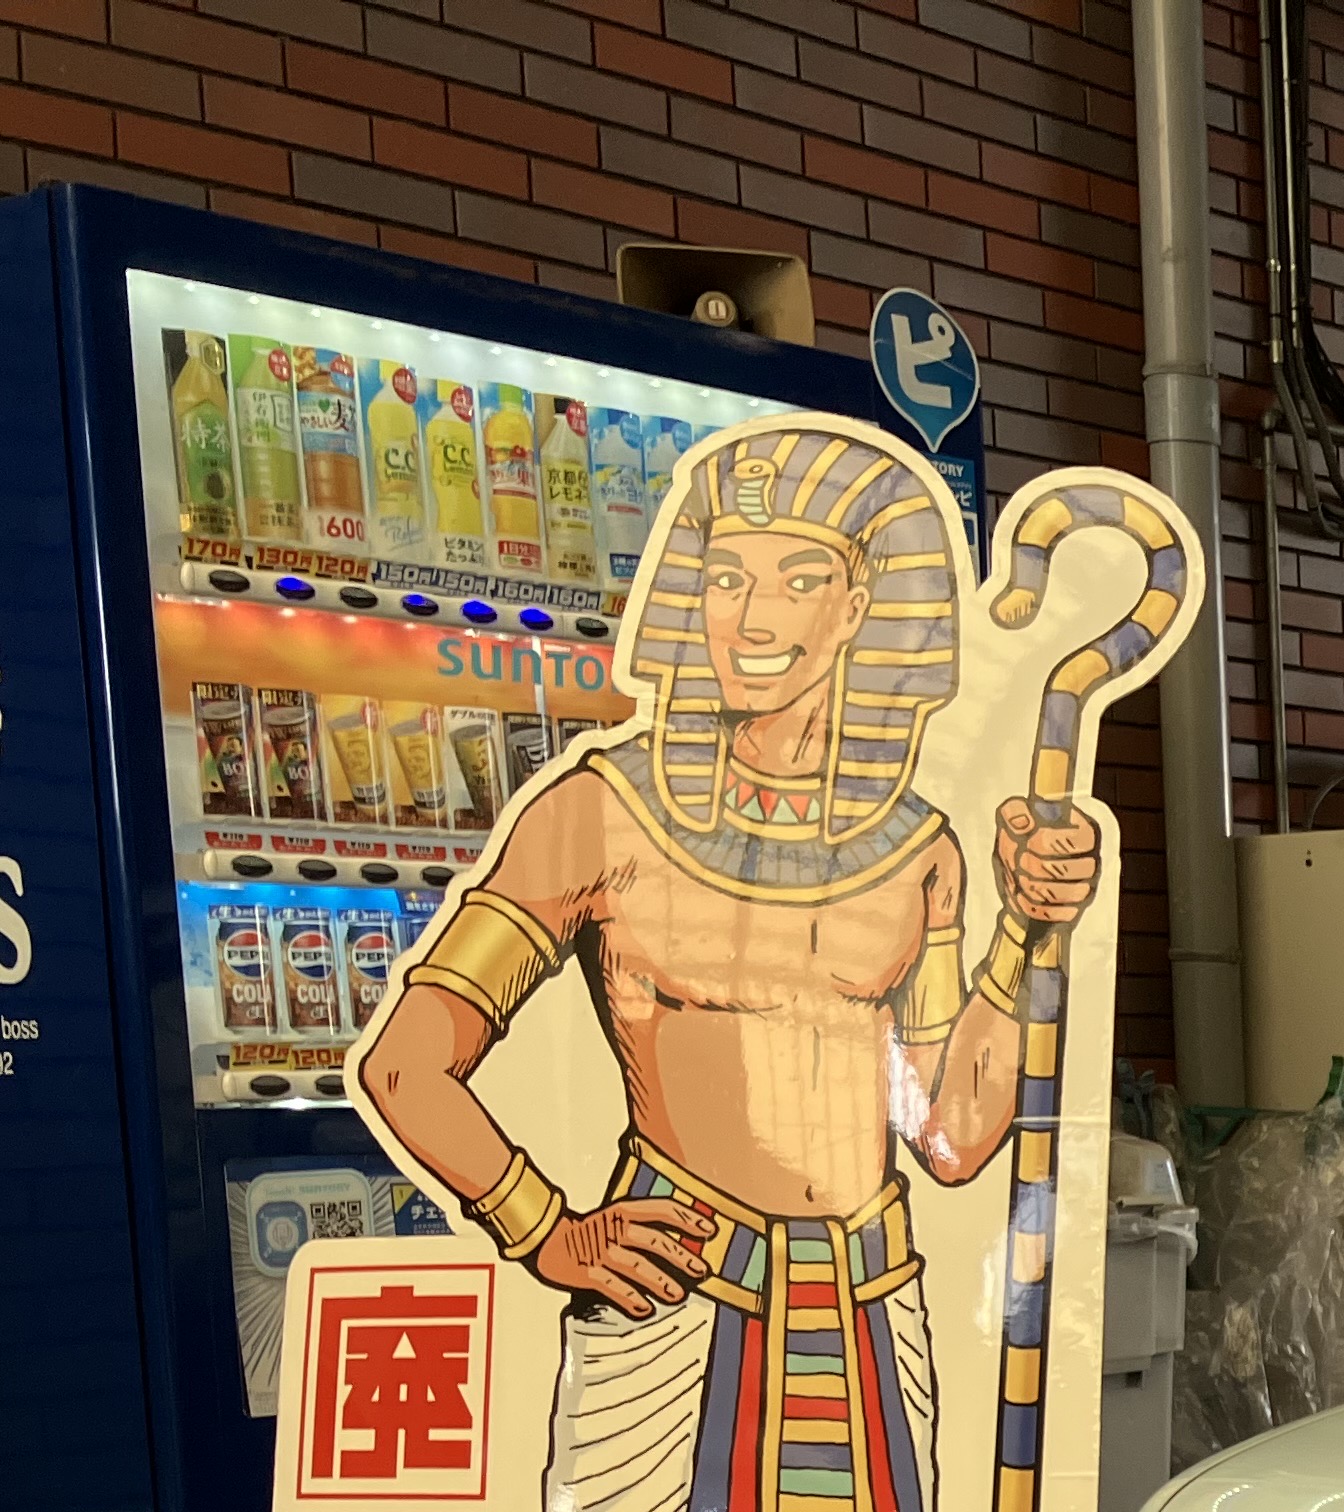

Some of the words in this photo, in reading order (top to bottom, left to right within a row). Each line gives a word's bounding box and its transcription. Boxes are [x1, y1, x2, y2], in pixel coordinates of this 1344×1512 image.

[890, 311, 956, 410] ピ
[187, 537, 241, 560] 170円
[257, 546, 313, 568] 130円
[316, 555, 369, 579] 120円
[380, 562, 432, 586] 150円
[439, 569, 487, 594] 150円
[437, 637, 618, 694] SUNTO
[1, 1017, 39, 1041] boss
[234, 1043, 289, 1062] 120円
